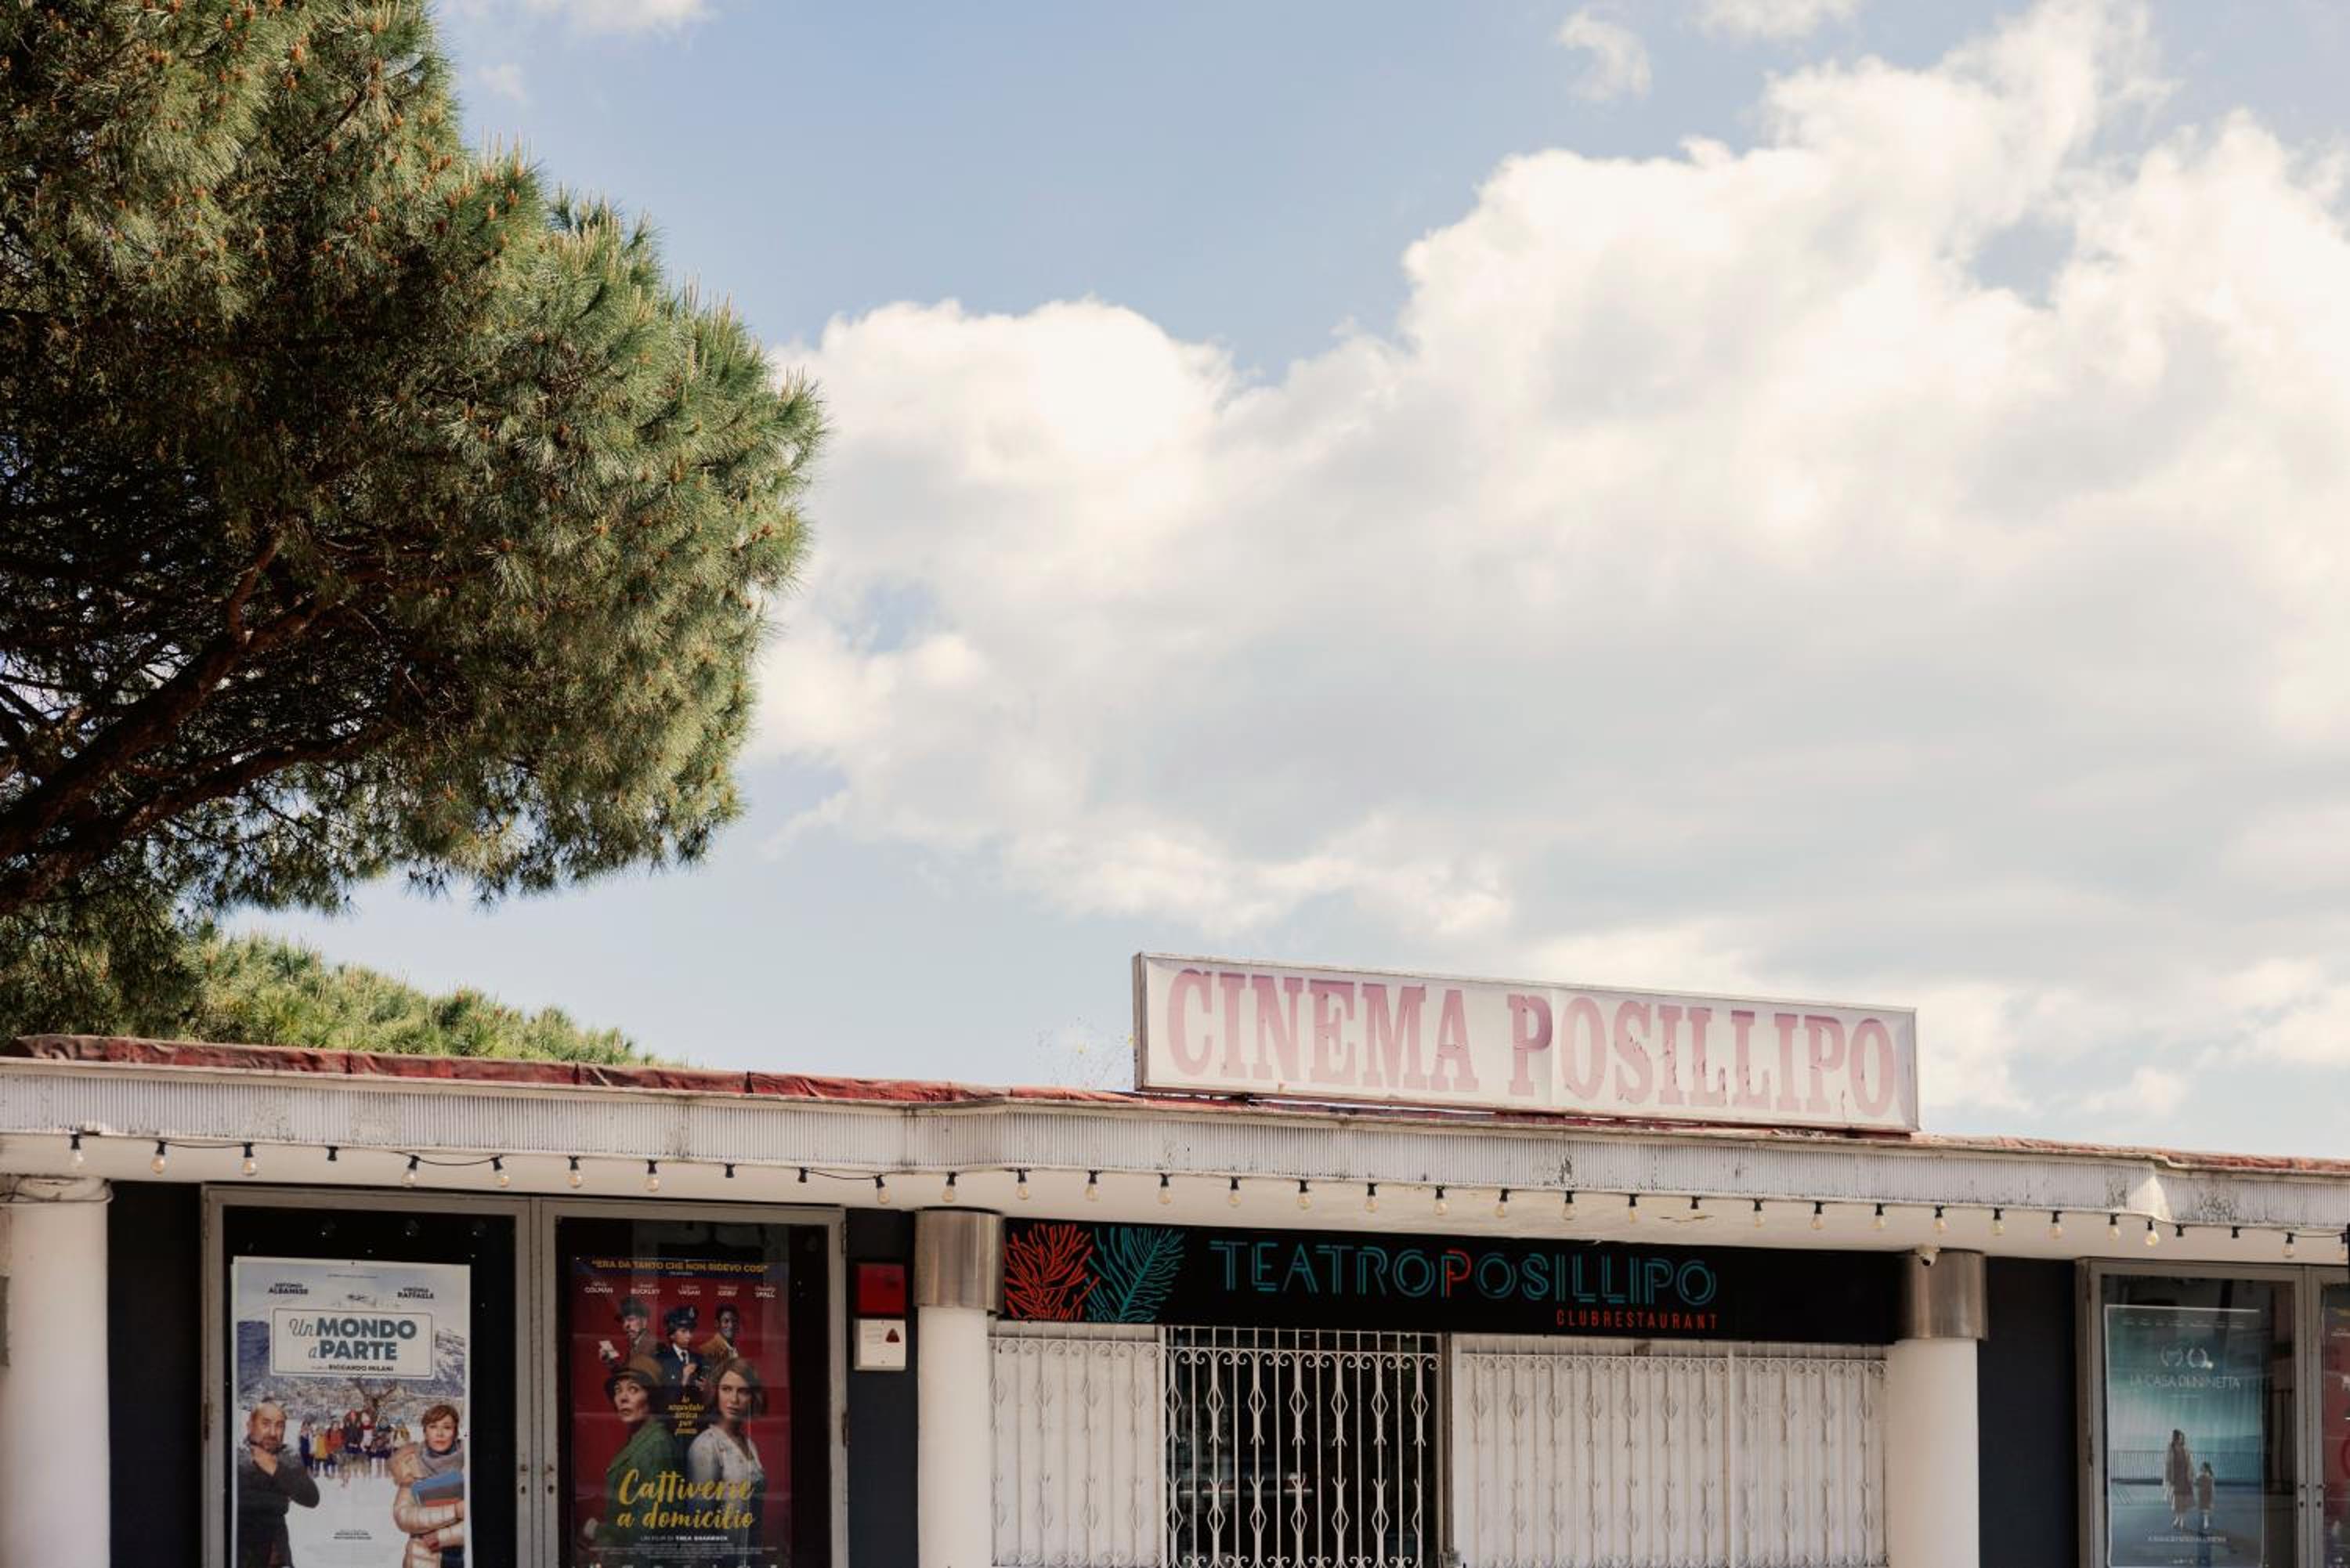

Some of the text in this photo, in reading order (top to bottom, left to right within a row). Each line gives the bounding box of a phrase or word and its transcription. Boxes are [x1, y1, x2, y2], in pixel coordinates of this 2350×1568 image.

[1167, 968, 1895, 1117] CINEMA POSILLIPO
[288, 1317, 418, 1340] Un MONDO
[308, 1340, 398, 1361] a PARTE
[616, 1501, 754, 1529] a domicilio
